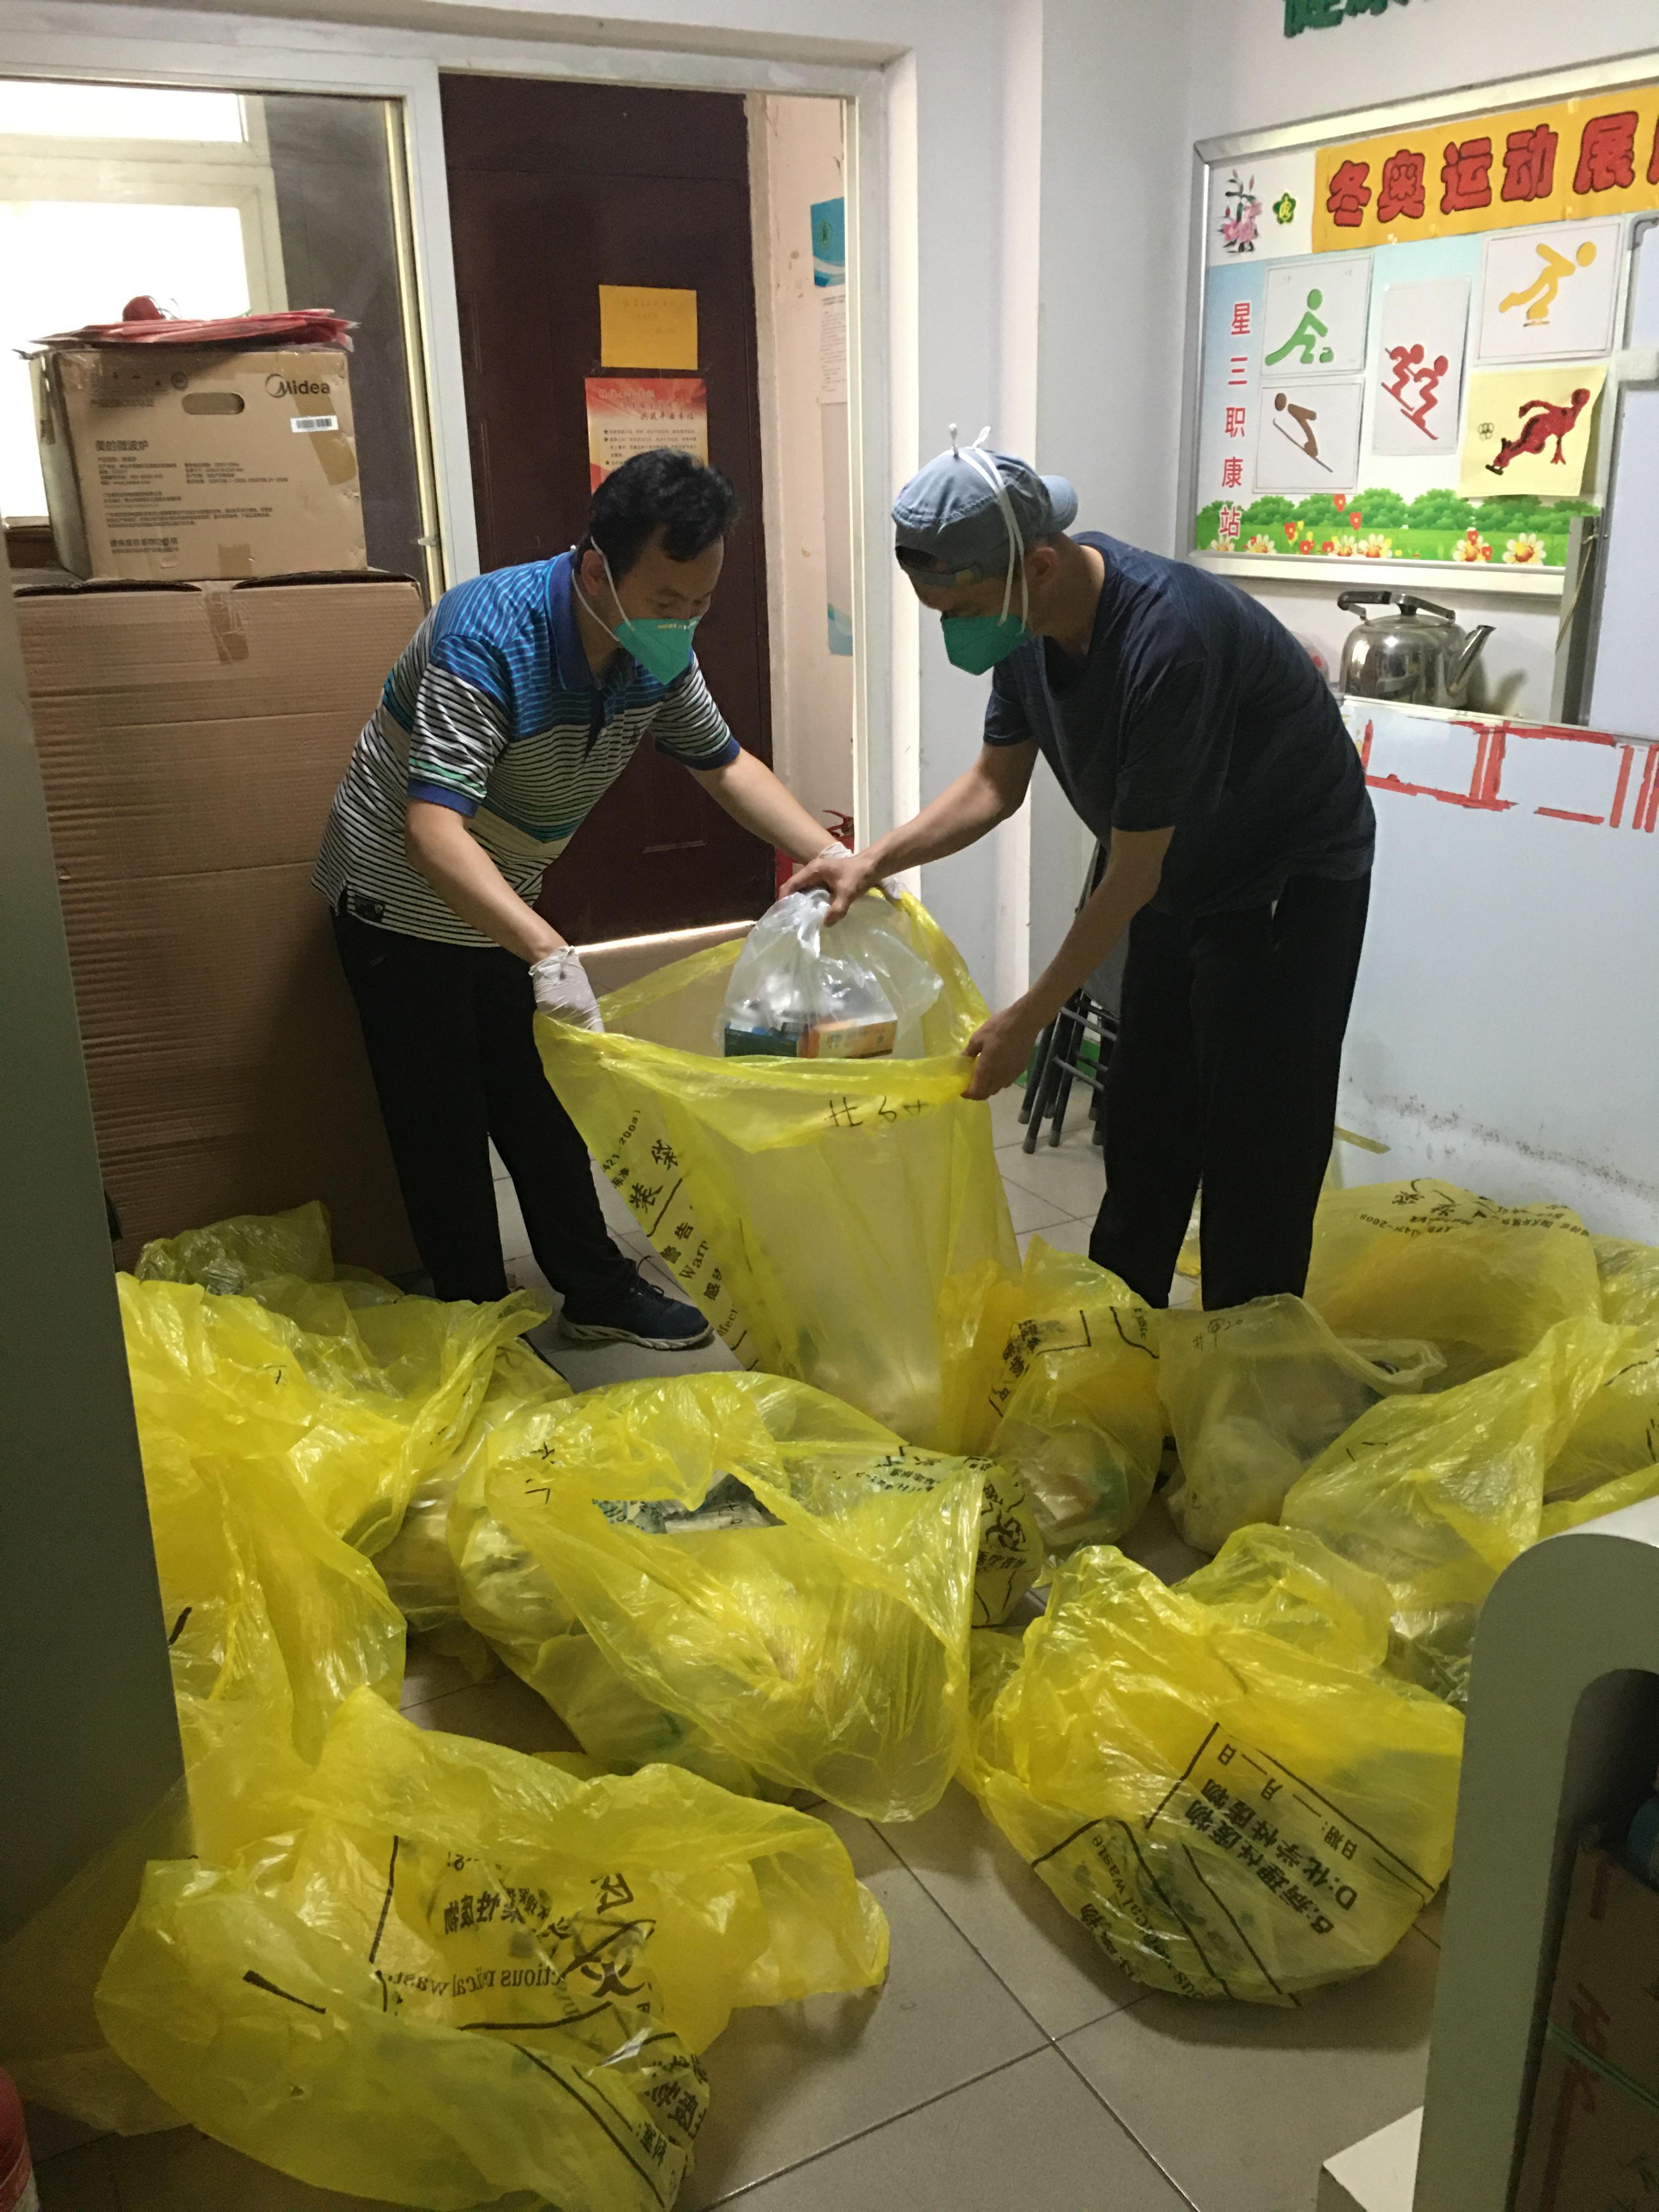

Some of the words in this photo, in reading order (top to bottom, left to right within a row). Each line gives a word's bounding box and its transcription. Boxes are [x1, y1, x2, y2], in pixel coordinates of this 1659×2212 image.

[1327, 109, 1659, 228] 冬奥运动展
[268, 375, 330, 397] Midea
[1219, 302, 1251, 539] 星三职康站
